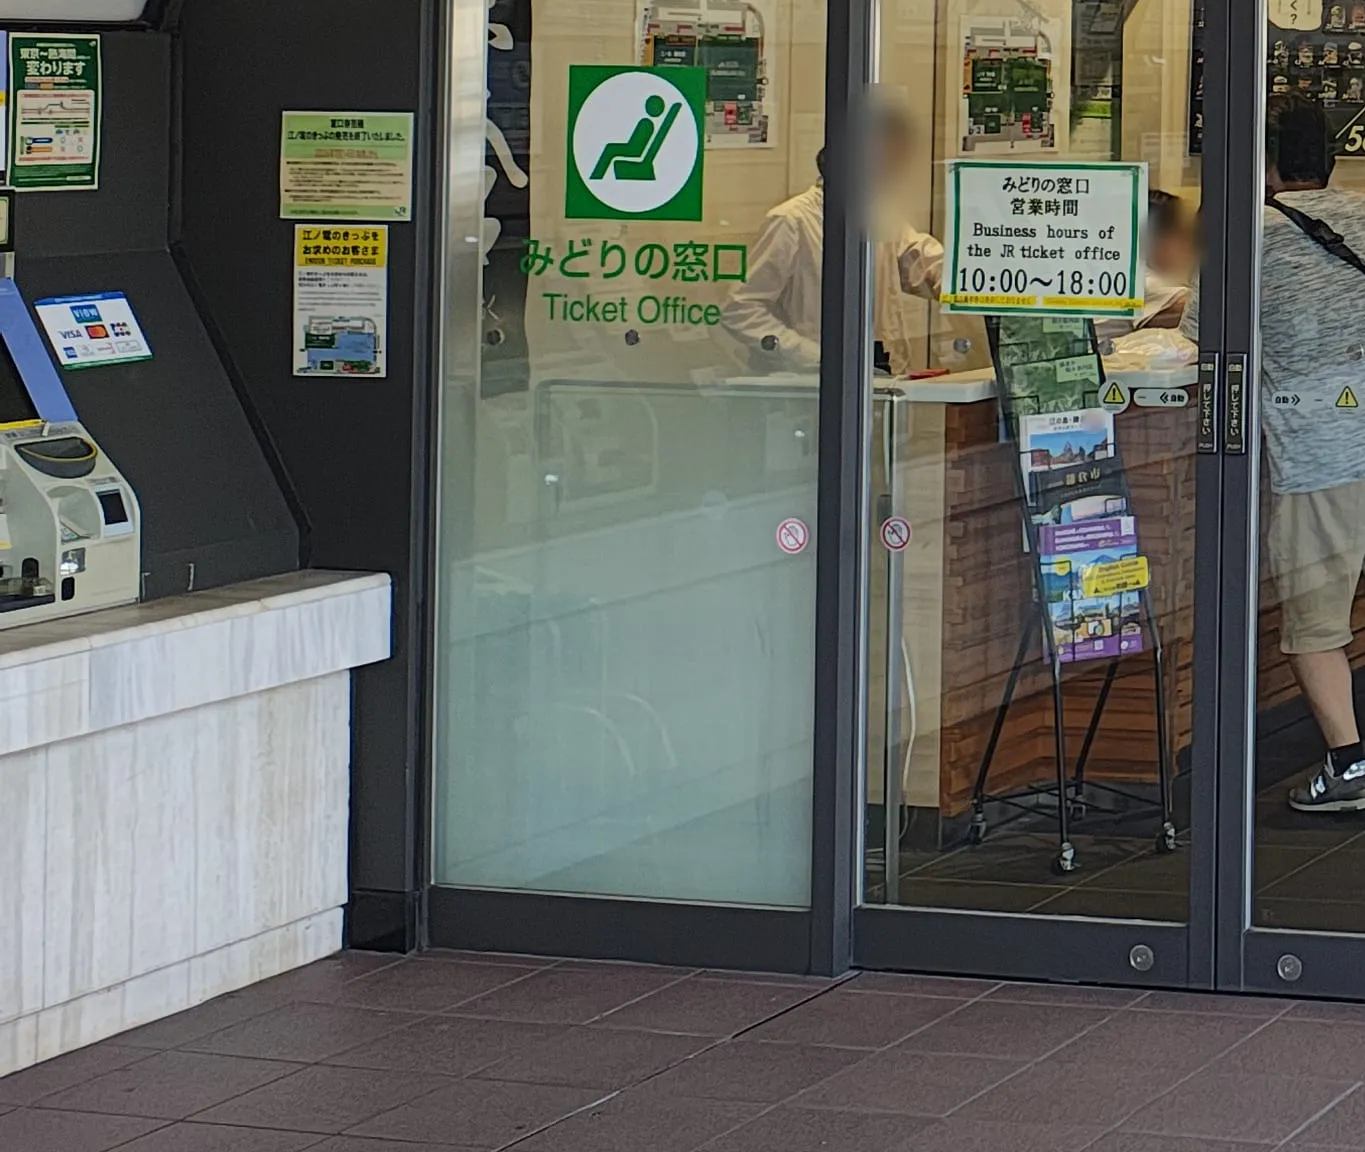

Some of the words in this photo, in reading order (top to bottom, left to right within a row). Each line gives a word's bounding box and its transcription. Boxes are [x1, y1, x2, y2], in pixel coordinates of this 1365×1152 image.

[26, 61, 86, 76] 変わります
[1002, 176, 1090, 194] みどりの窓口
[1010, 198, 1079, 216] 営業時間
[303, 230, 379, 241] 江ノ電のきっぷを
[973, 223, 1037, 238] Business
[1047, 225, 1088, 239] hours
[1098, 226, 1115, 240] of
[519, 238, 747, 283] みどりの窓口
[967, 244, 991, 257] the
[1000, 245, 1015, 258] JR
[1021, 245, 1064, 259] ticket
[1075, 246, 1120, 260] office
[542, 293, 627, 324] Ticket
[638, 296, 721, 326] Office
[59, 330, 83, 339] VISA
